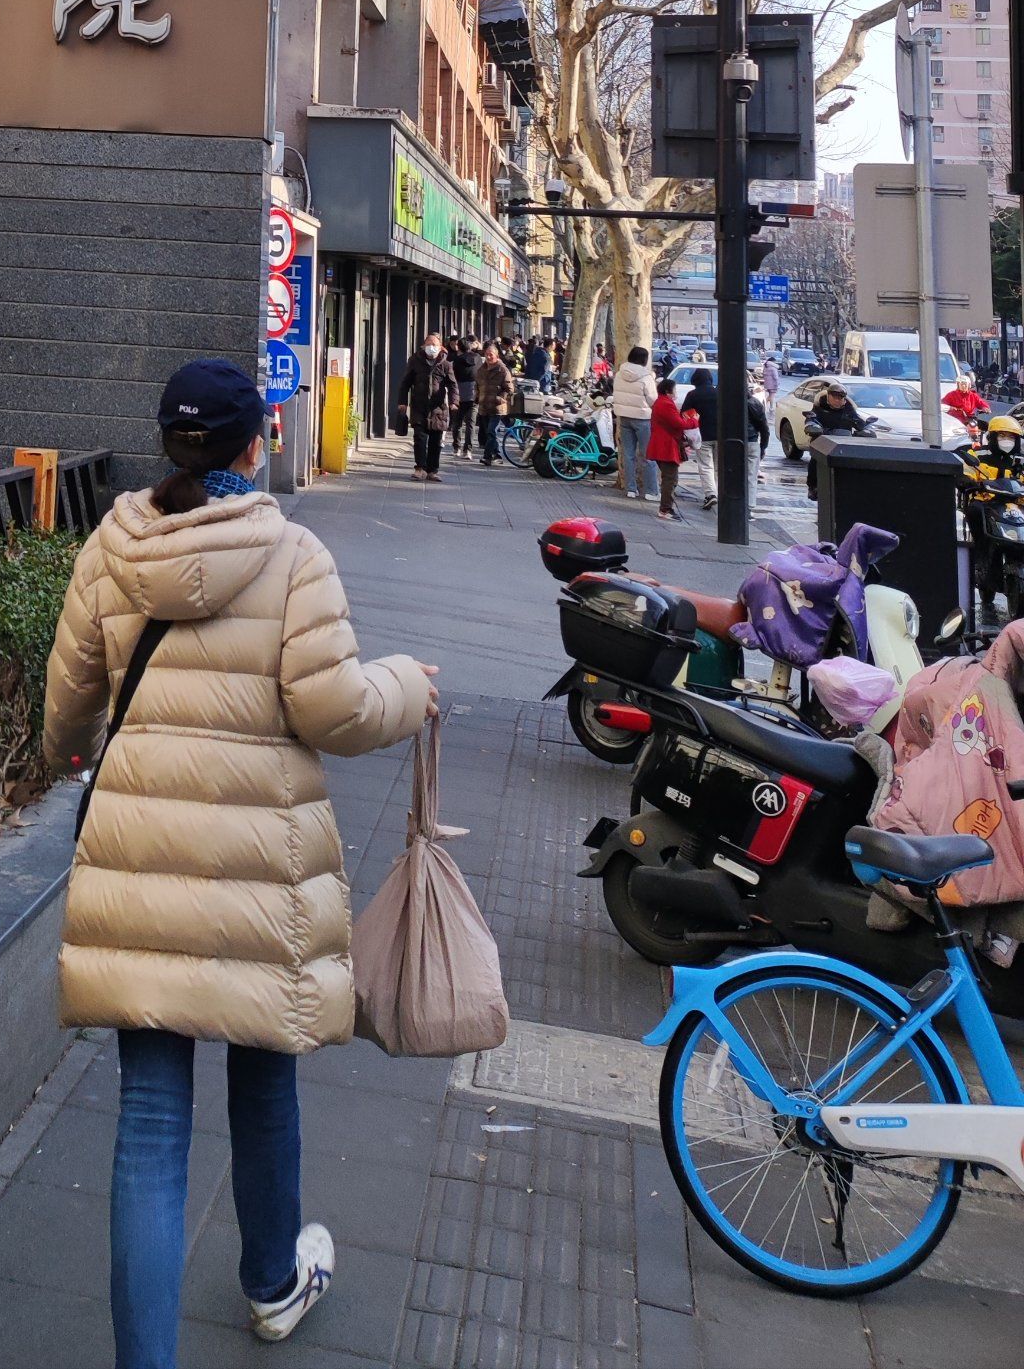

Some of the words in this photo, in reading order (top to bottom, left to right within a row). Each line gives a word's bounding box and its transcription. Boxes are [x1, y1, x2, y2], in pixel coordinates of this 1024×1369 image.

[270, 223, 285, 258] 5
[178, 404, 199, 414] POLO
[665, 785, 692, 808] 爱玛
